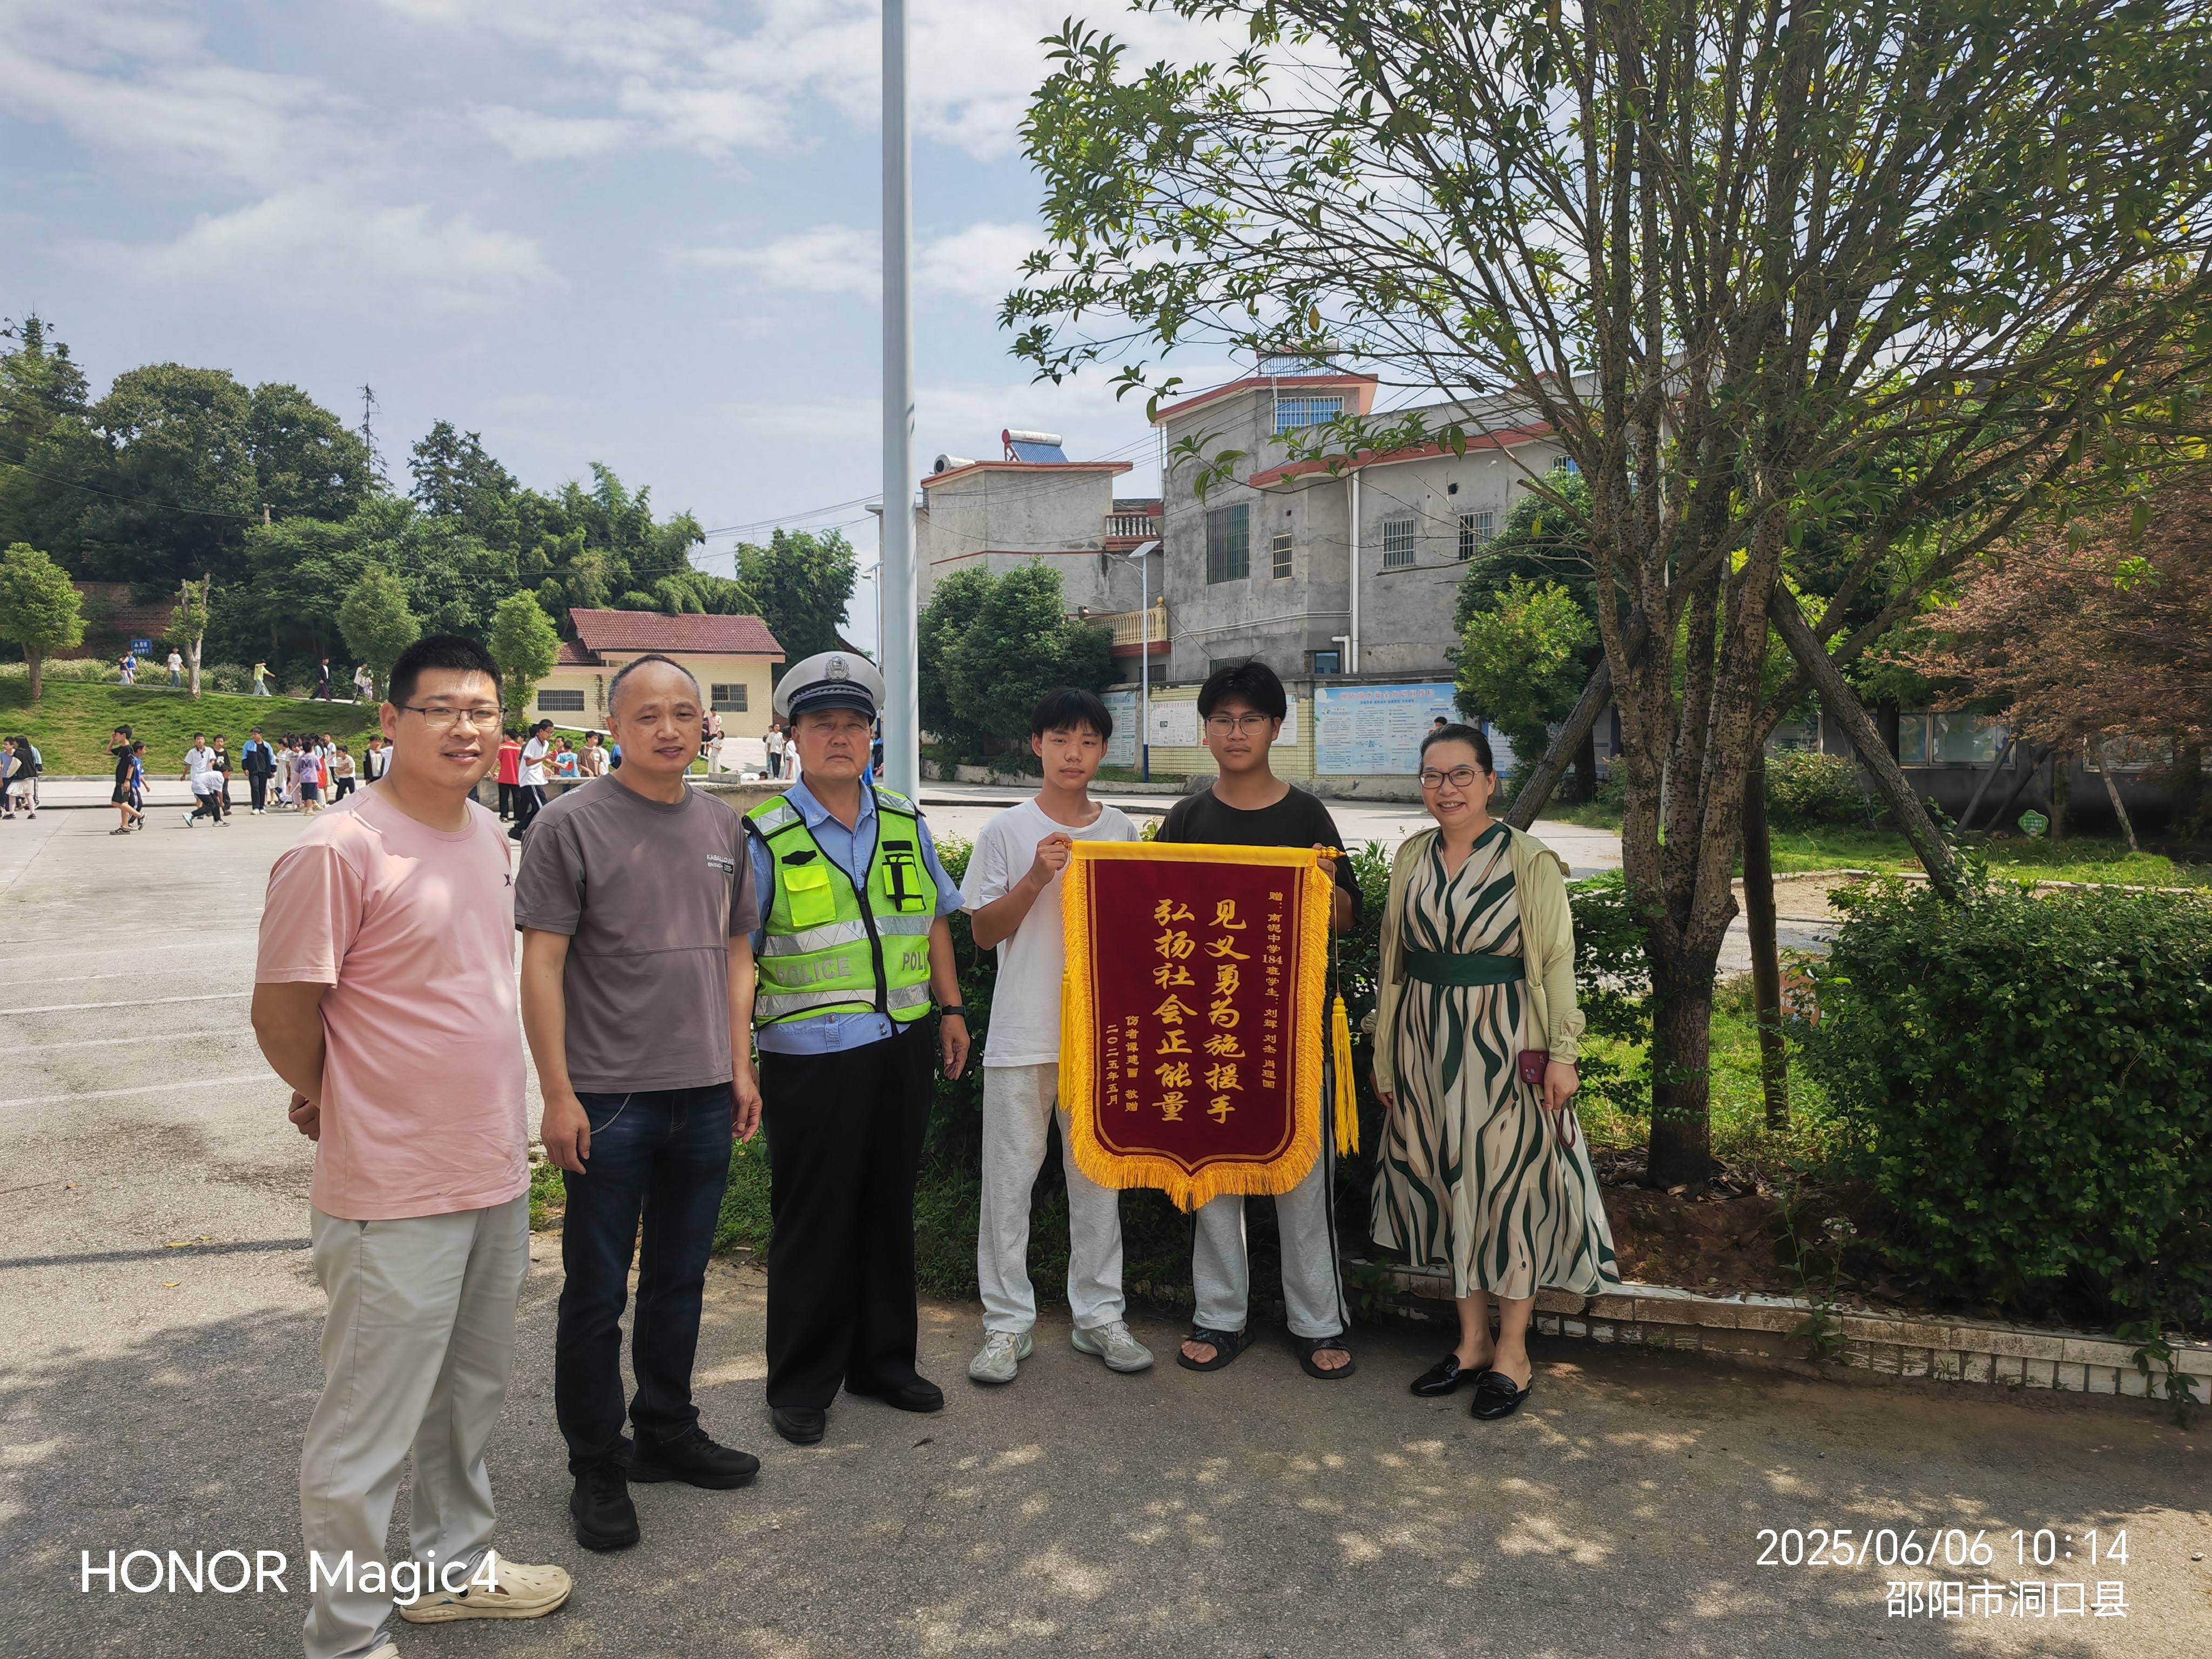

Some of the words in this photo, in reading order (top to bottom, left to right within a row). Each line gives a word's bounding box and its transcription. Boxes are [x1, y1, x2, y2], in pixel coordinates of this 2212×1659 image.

[777, 956, 852, 987] POLICE
[901, 951, 928, 971] POLI
[1152, 898, 1198, 1121] 弘扬社会正能量
[1203, 899, 1251, 1124] 见义勇为施援手
